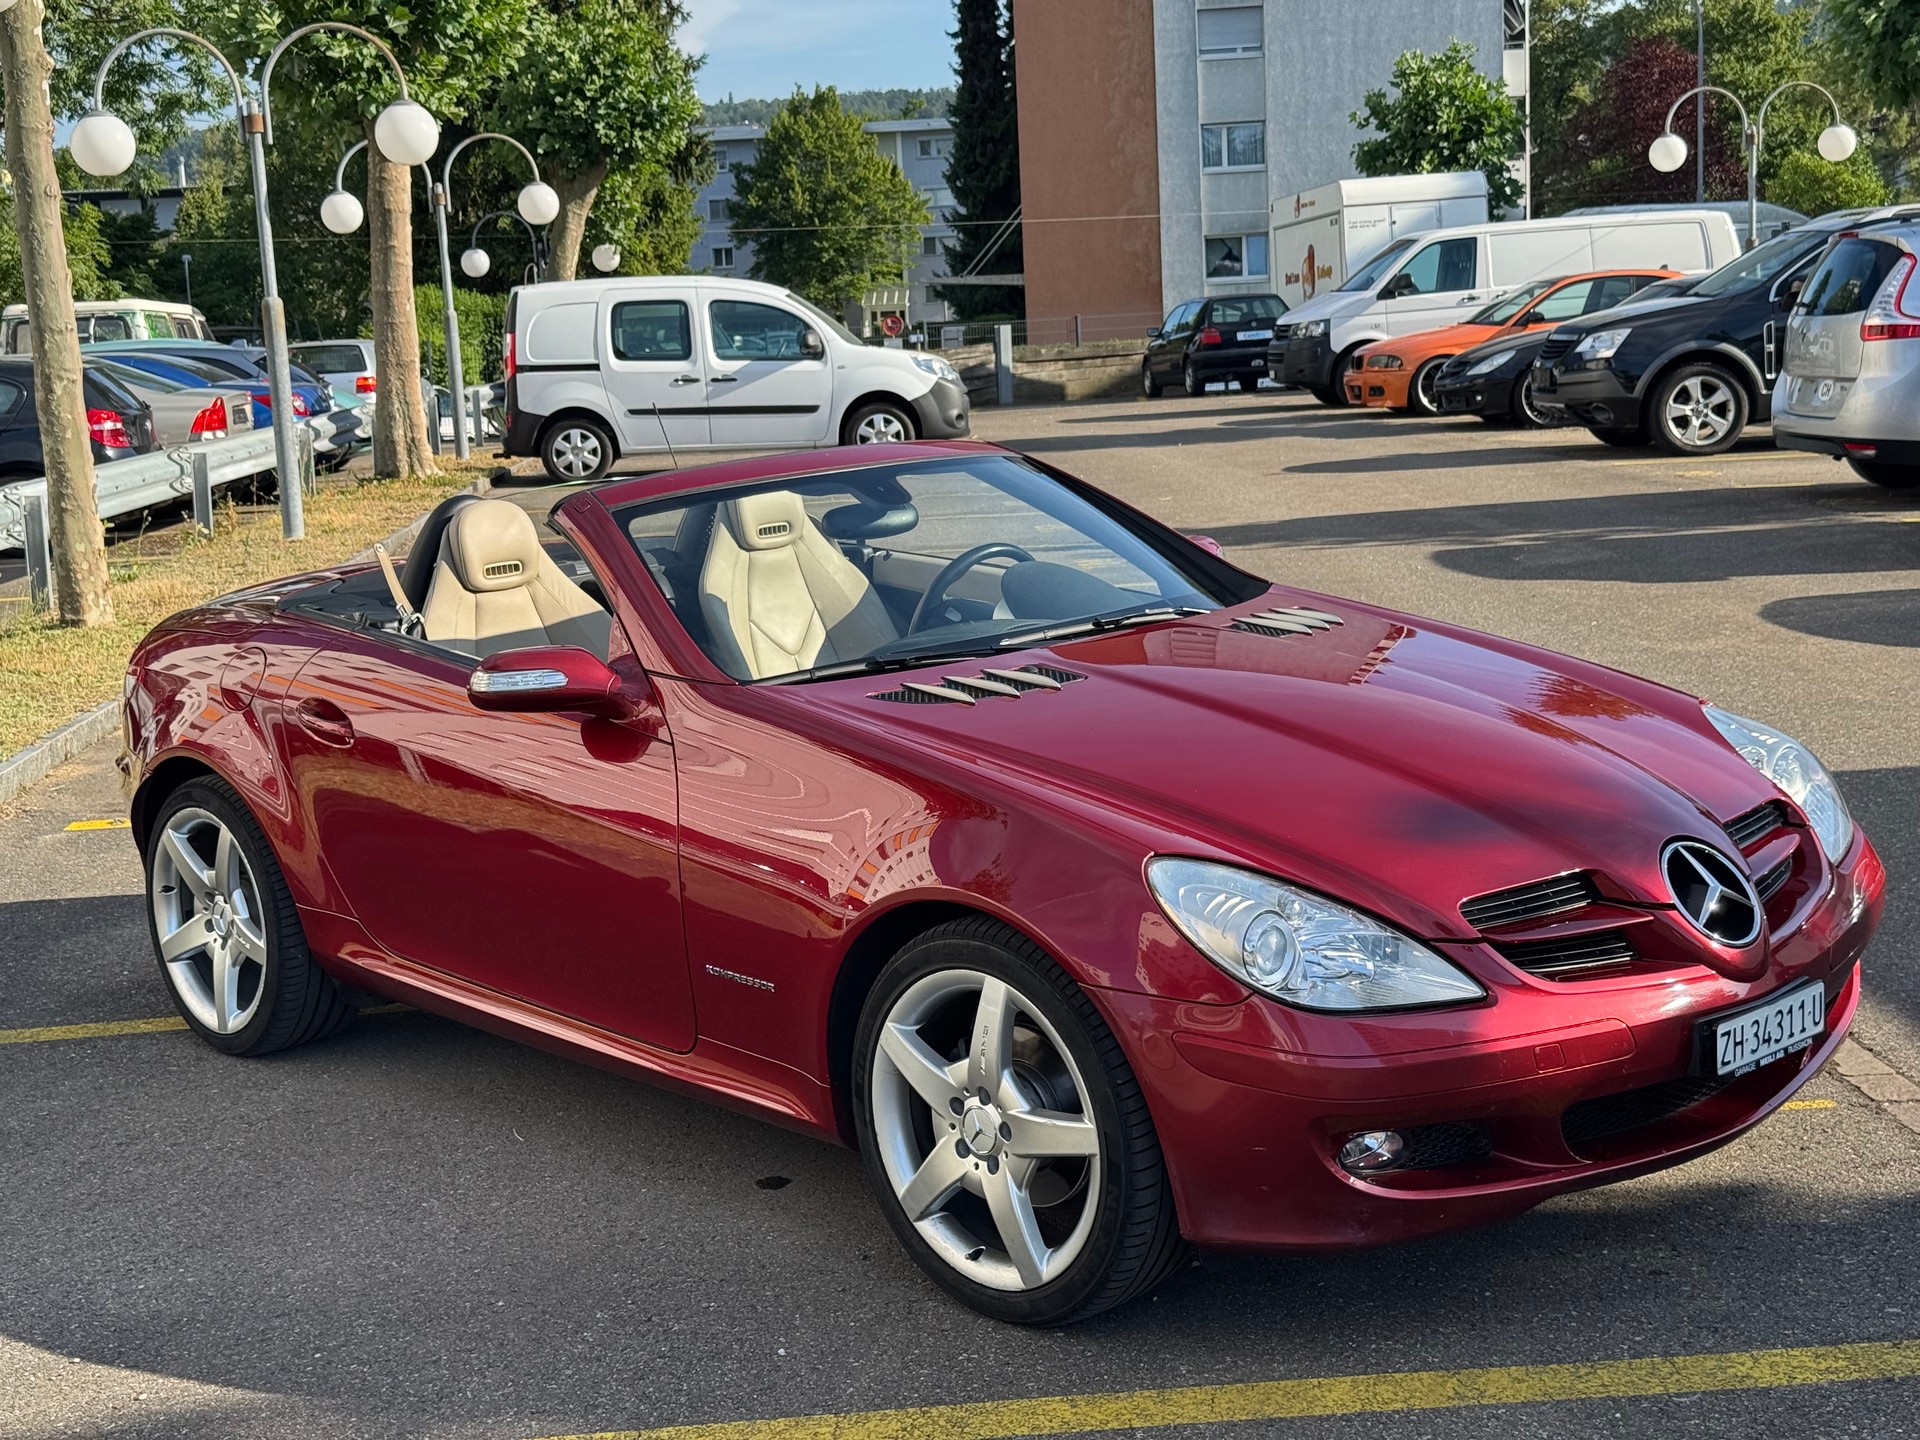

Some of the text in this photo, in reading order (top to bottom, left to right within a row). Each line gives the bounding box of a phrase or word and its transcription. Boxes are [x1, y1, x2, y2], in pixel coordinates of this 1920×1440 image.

[1821, 383, 1832, 397] CH
[705, 964, 775, 993] KOMPRESSOR
[1734, 1061, 1757, 1077] GARAGE
